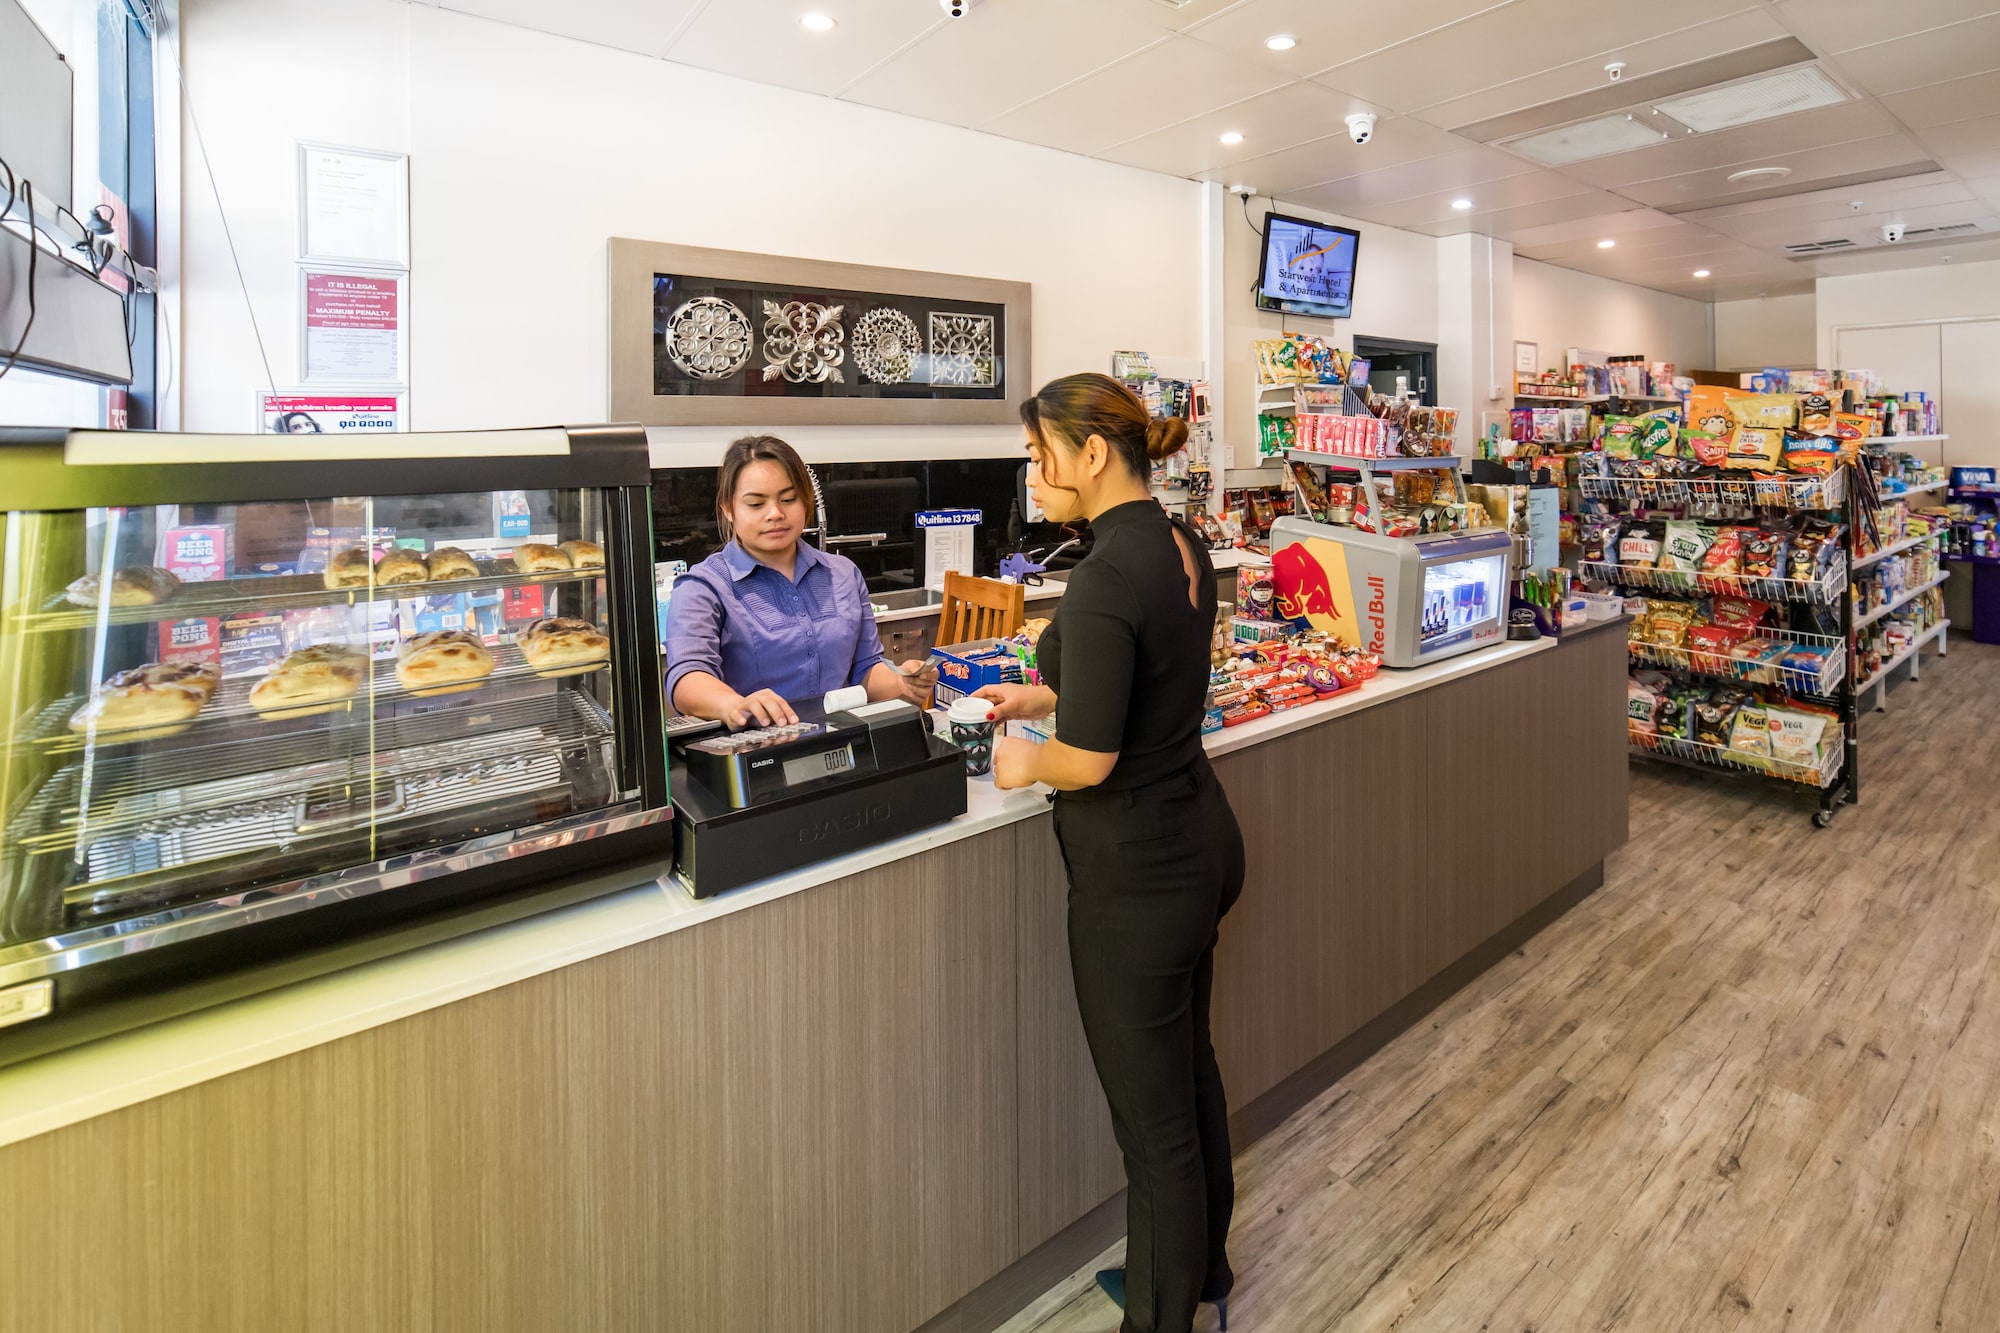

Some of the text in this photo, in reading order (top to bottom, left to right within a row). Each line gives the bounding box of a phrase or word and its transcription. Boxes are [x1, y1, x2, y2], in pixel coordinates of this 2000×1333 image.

[1278, 268, 1342, 287] Starwest Hotel
[345, 282, 378, 290] ILLEGAL
[1278, 282, 1339, 299] & Apartments
[316, 307, 390, 317] MAXIMUM PENALTY
[294, 404, 324, 412] children
[352, 405, 369, 413] your
[1960, 471, 1991, 482] VIVA
[918, 513, 980, 527] Quitline 13 7848
[176, 540, 213, 549] BEER
[176, 547, 214, 557] PONG
[1368, 576, 1385, 655] Red Bull
[171, 623, 209, 635] BEER
[171, 632, 210, 643] PONG
[1743, 713, 1766, 726] VEGE
[1783, 719, 1804, 730] VEGE
[751, 758, 774, 769] CASIO
